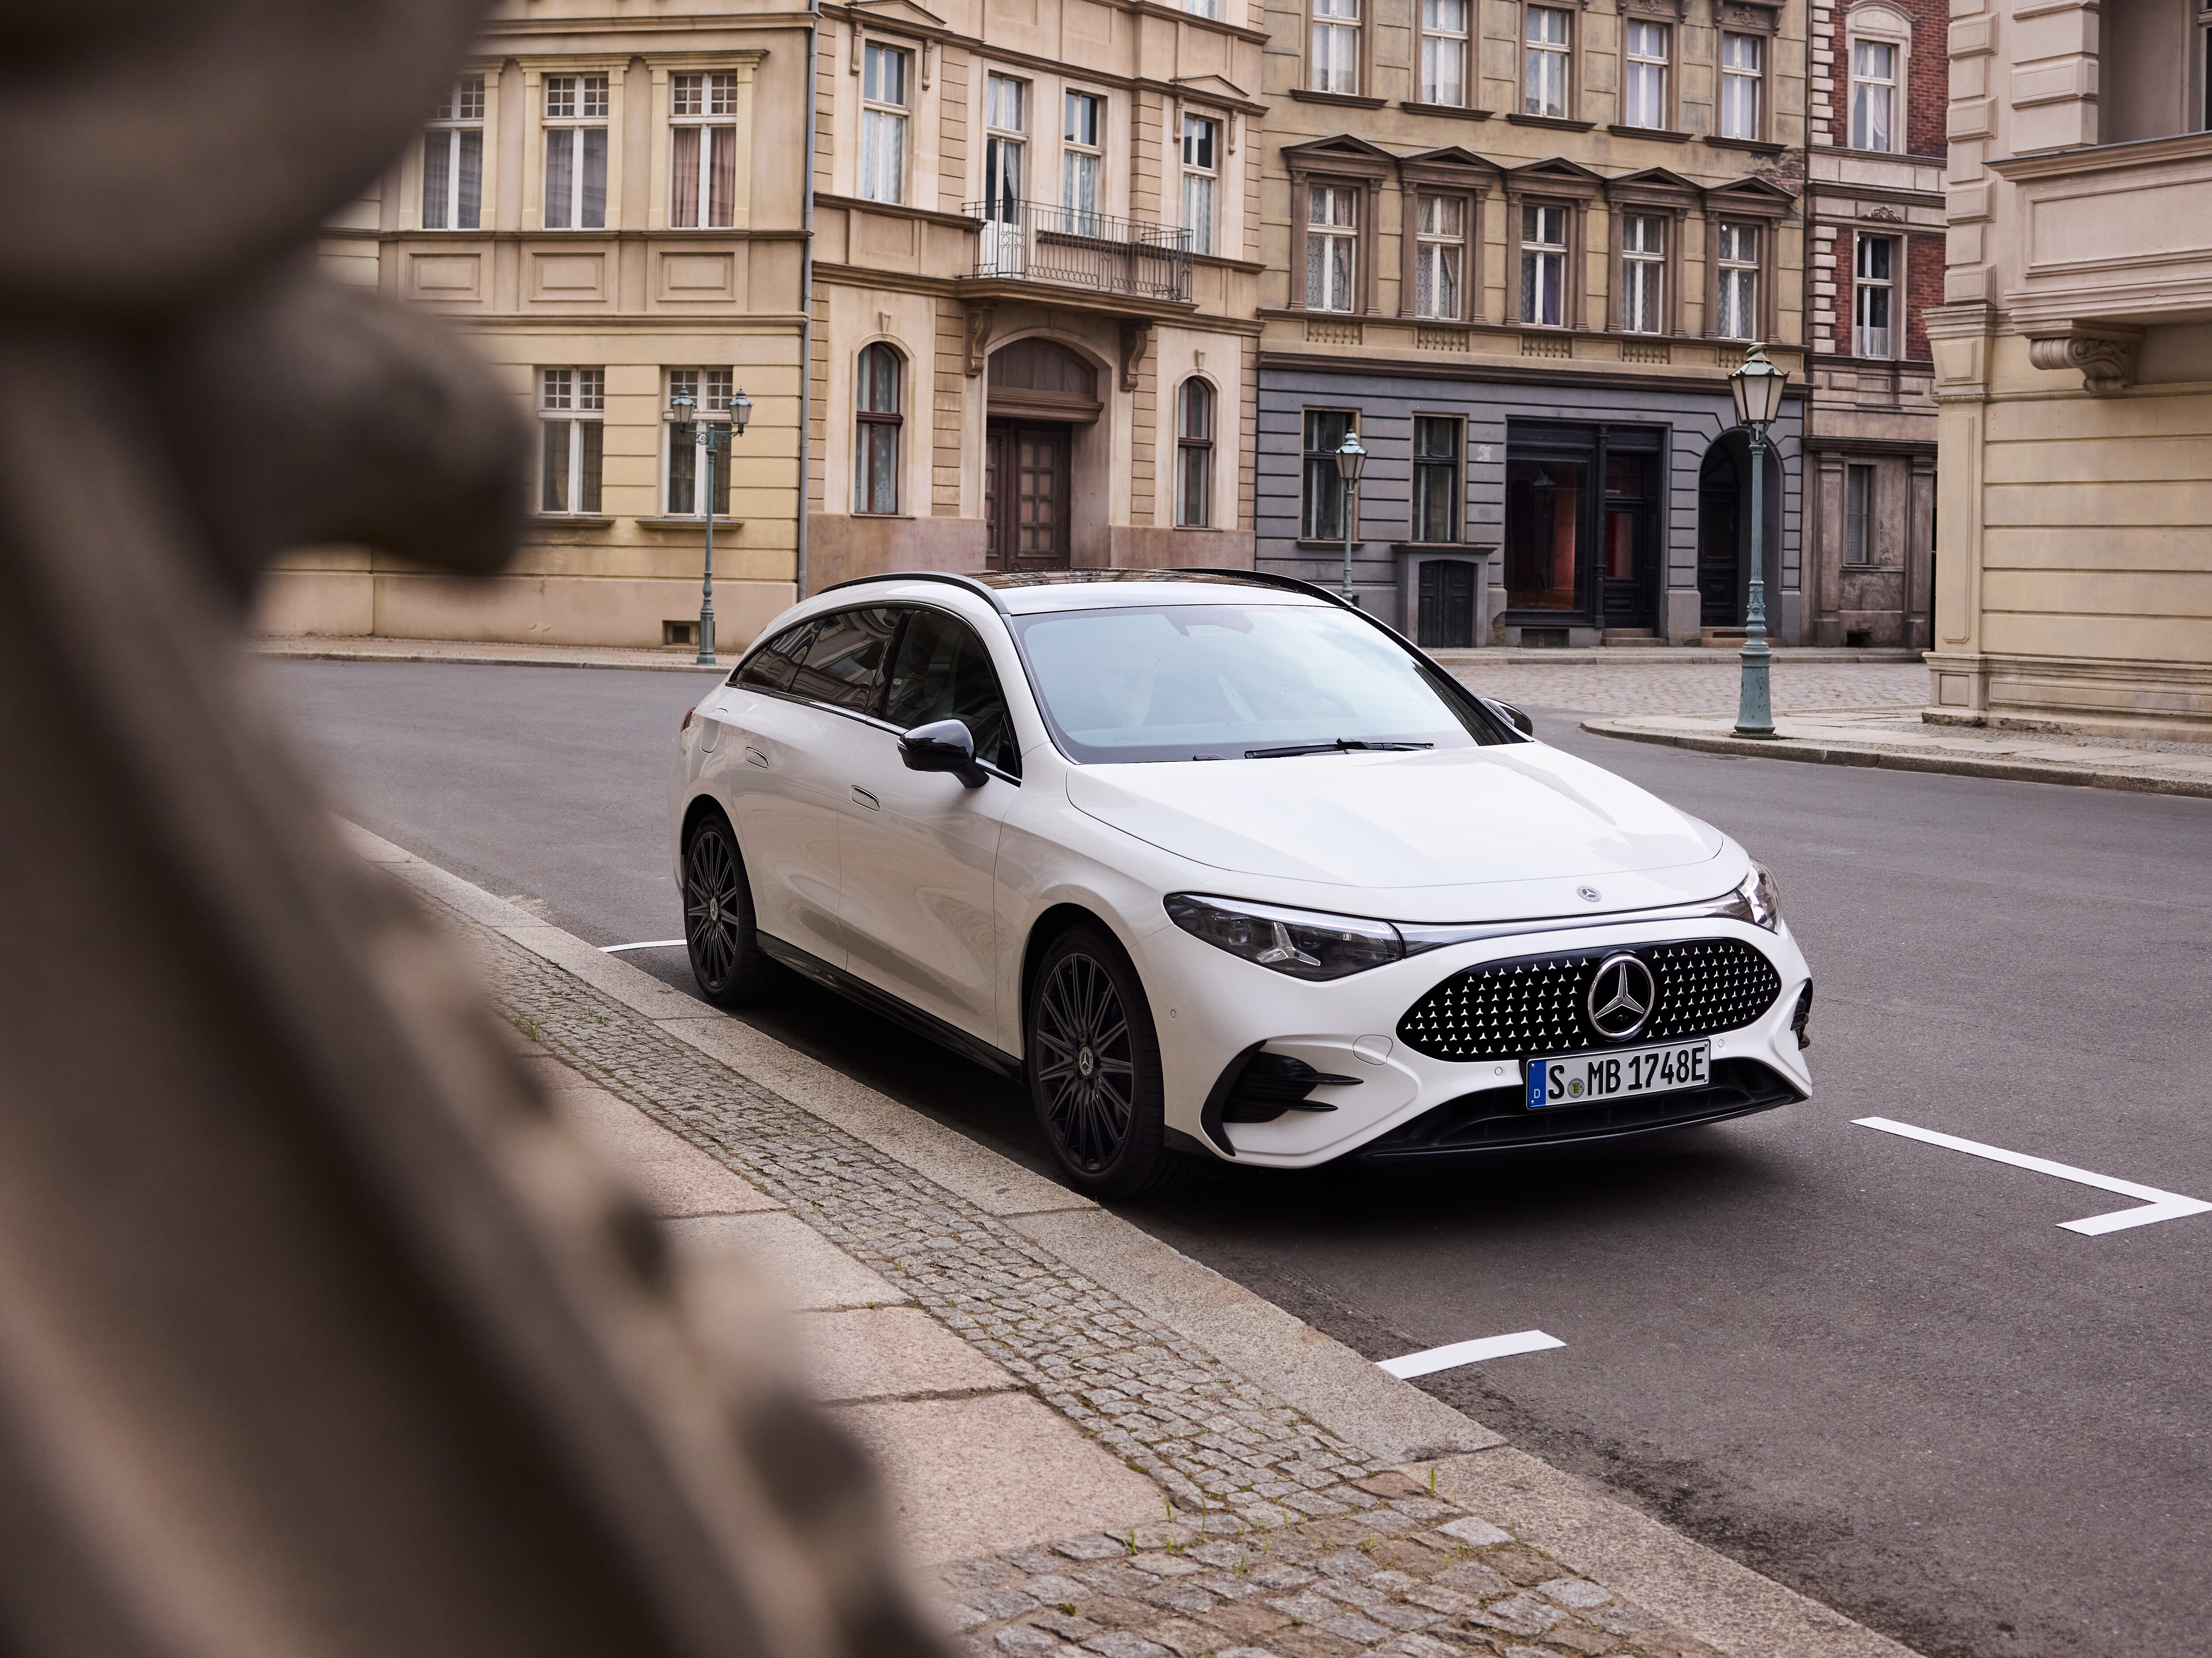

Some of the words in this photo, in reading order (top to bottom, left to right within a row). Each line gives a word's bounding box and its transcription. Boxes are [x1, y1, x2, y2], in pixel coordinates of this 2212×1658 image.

[1548, 1065, 1565, 1099] S
[1587, 1059, 1621, 1096] MB
[1628, 1046, 1705, 1090] 1748E
[1534, 1089, 1540, 1099] D
